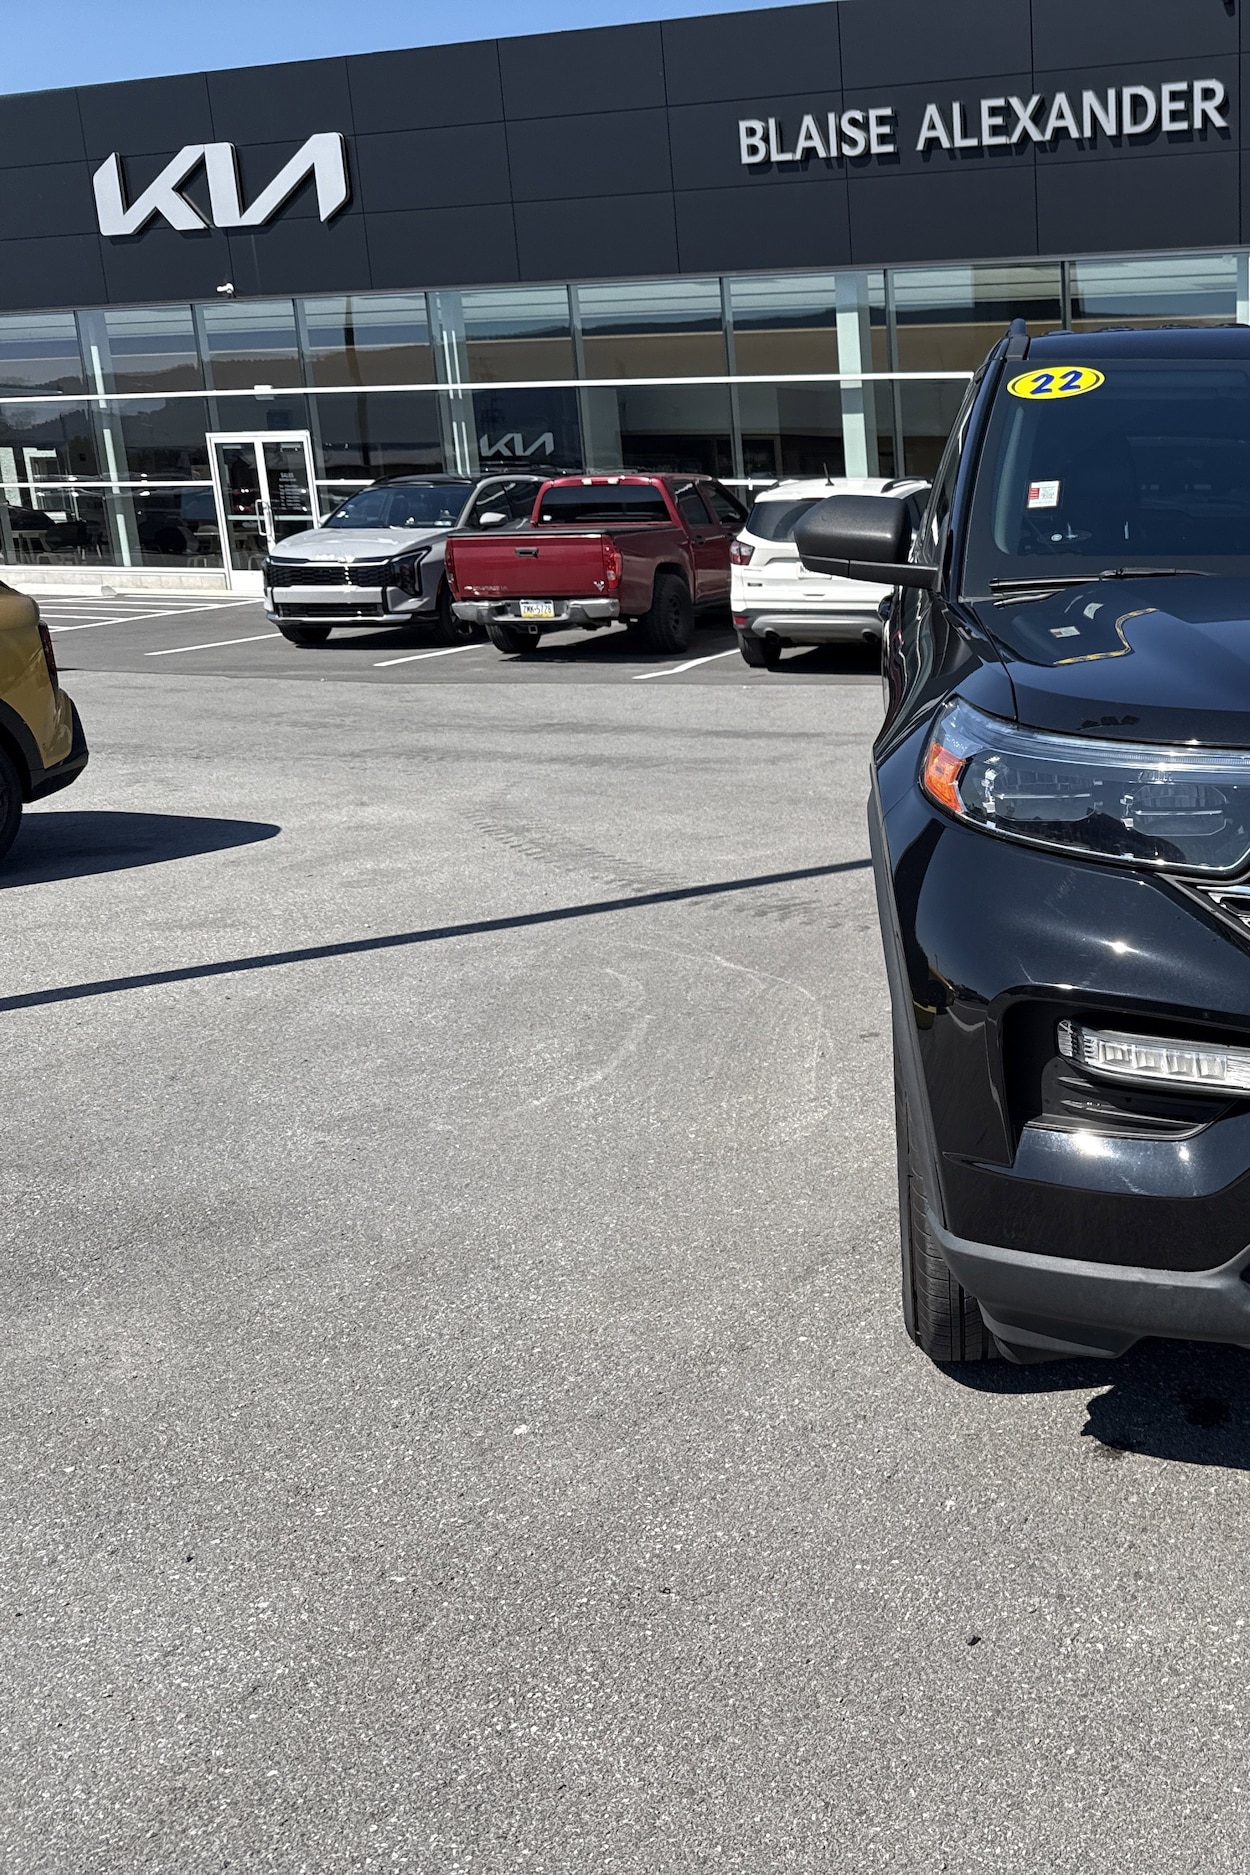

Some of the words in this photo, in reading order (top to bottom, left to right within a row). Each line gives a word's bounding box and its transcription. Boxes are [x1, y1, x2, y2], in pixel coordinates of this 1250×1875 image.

[738, 106, 897, 164] BLAISE
[916, 78, 1229, 150] ALEXANDER
[93, 131, 348, 236] KIA
[1029, 369, 1083, 395] 22
[480, 431, 554, 457] KIA
